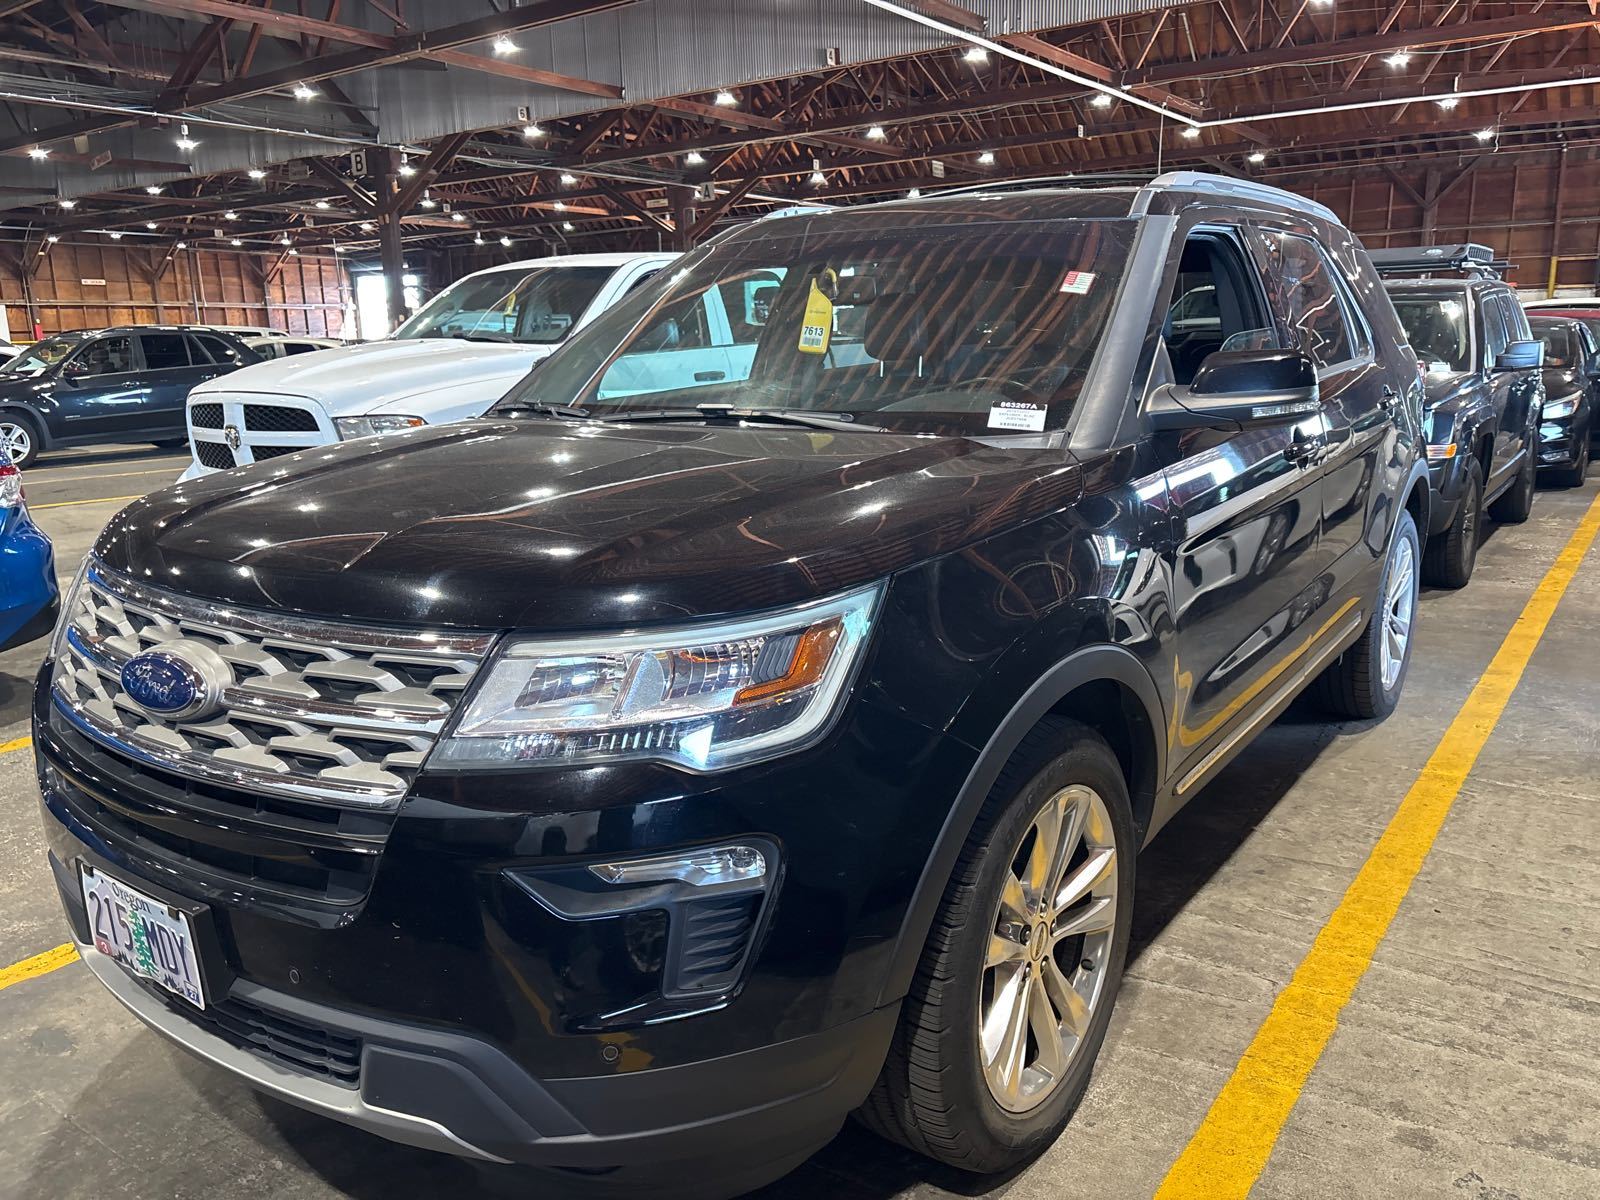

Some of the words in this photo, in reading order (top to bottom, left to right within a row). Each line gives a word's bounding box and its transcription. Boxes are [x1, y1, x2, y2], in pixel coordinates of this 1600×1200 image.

[354, 154, 364, 172] B
[703, 184, 711, 199] A
[803, 326, 824, 337] 7613
[112, 882, 152, 914] Oregon
[89, 891, 135, 952] 215
[141, 915, 191, 983] MDY
[100, 941, 109, 954] 3
